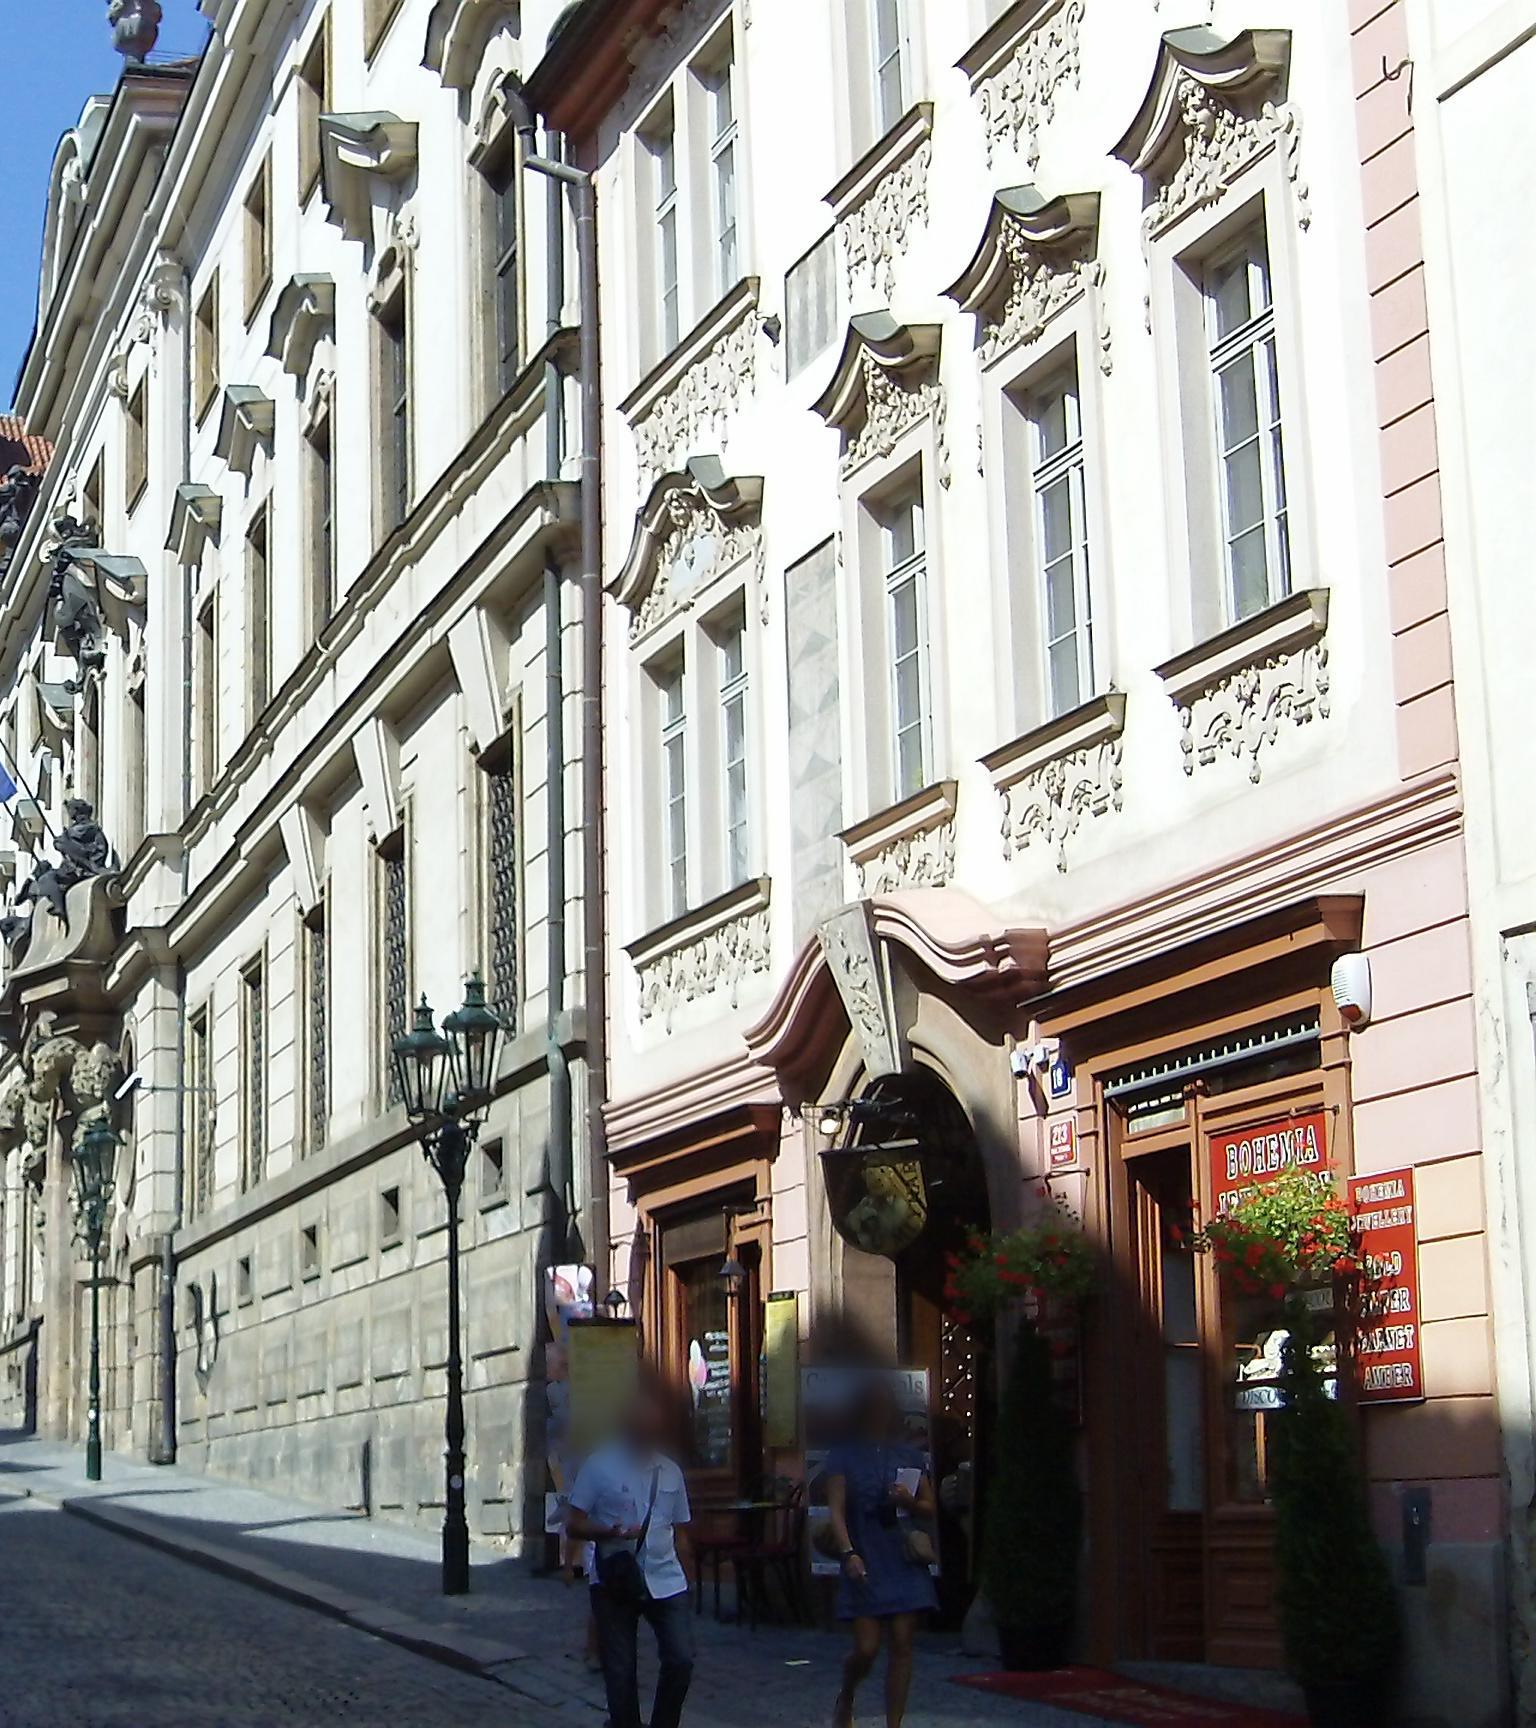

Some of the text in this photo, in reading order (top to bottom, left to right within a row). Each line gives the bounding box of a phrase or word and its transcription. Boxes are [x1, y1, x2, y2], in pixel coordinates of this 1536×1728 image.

[1225, 1124, 1319, 1180] BOHEMIA
[1354, 1178, 1405, 1204] BOHEMIA
[1364, 1362, 1414, 1391] AMBER
